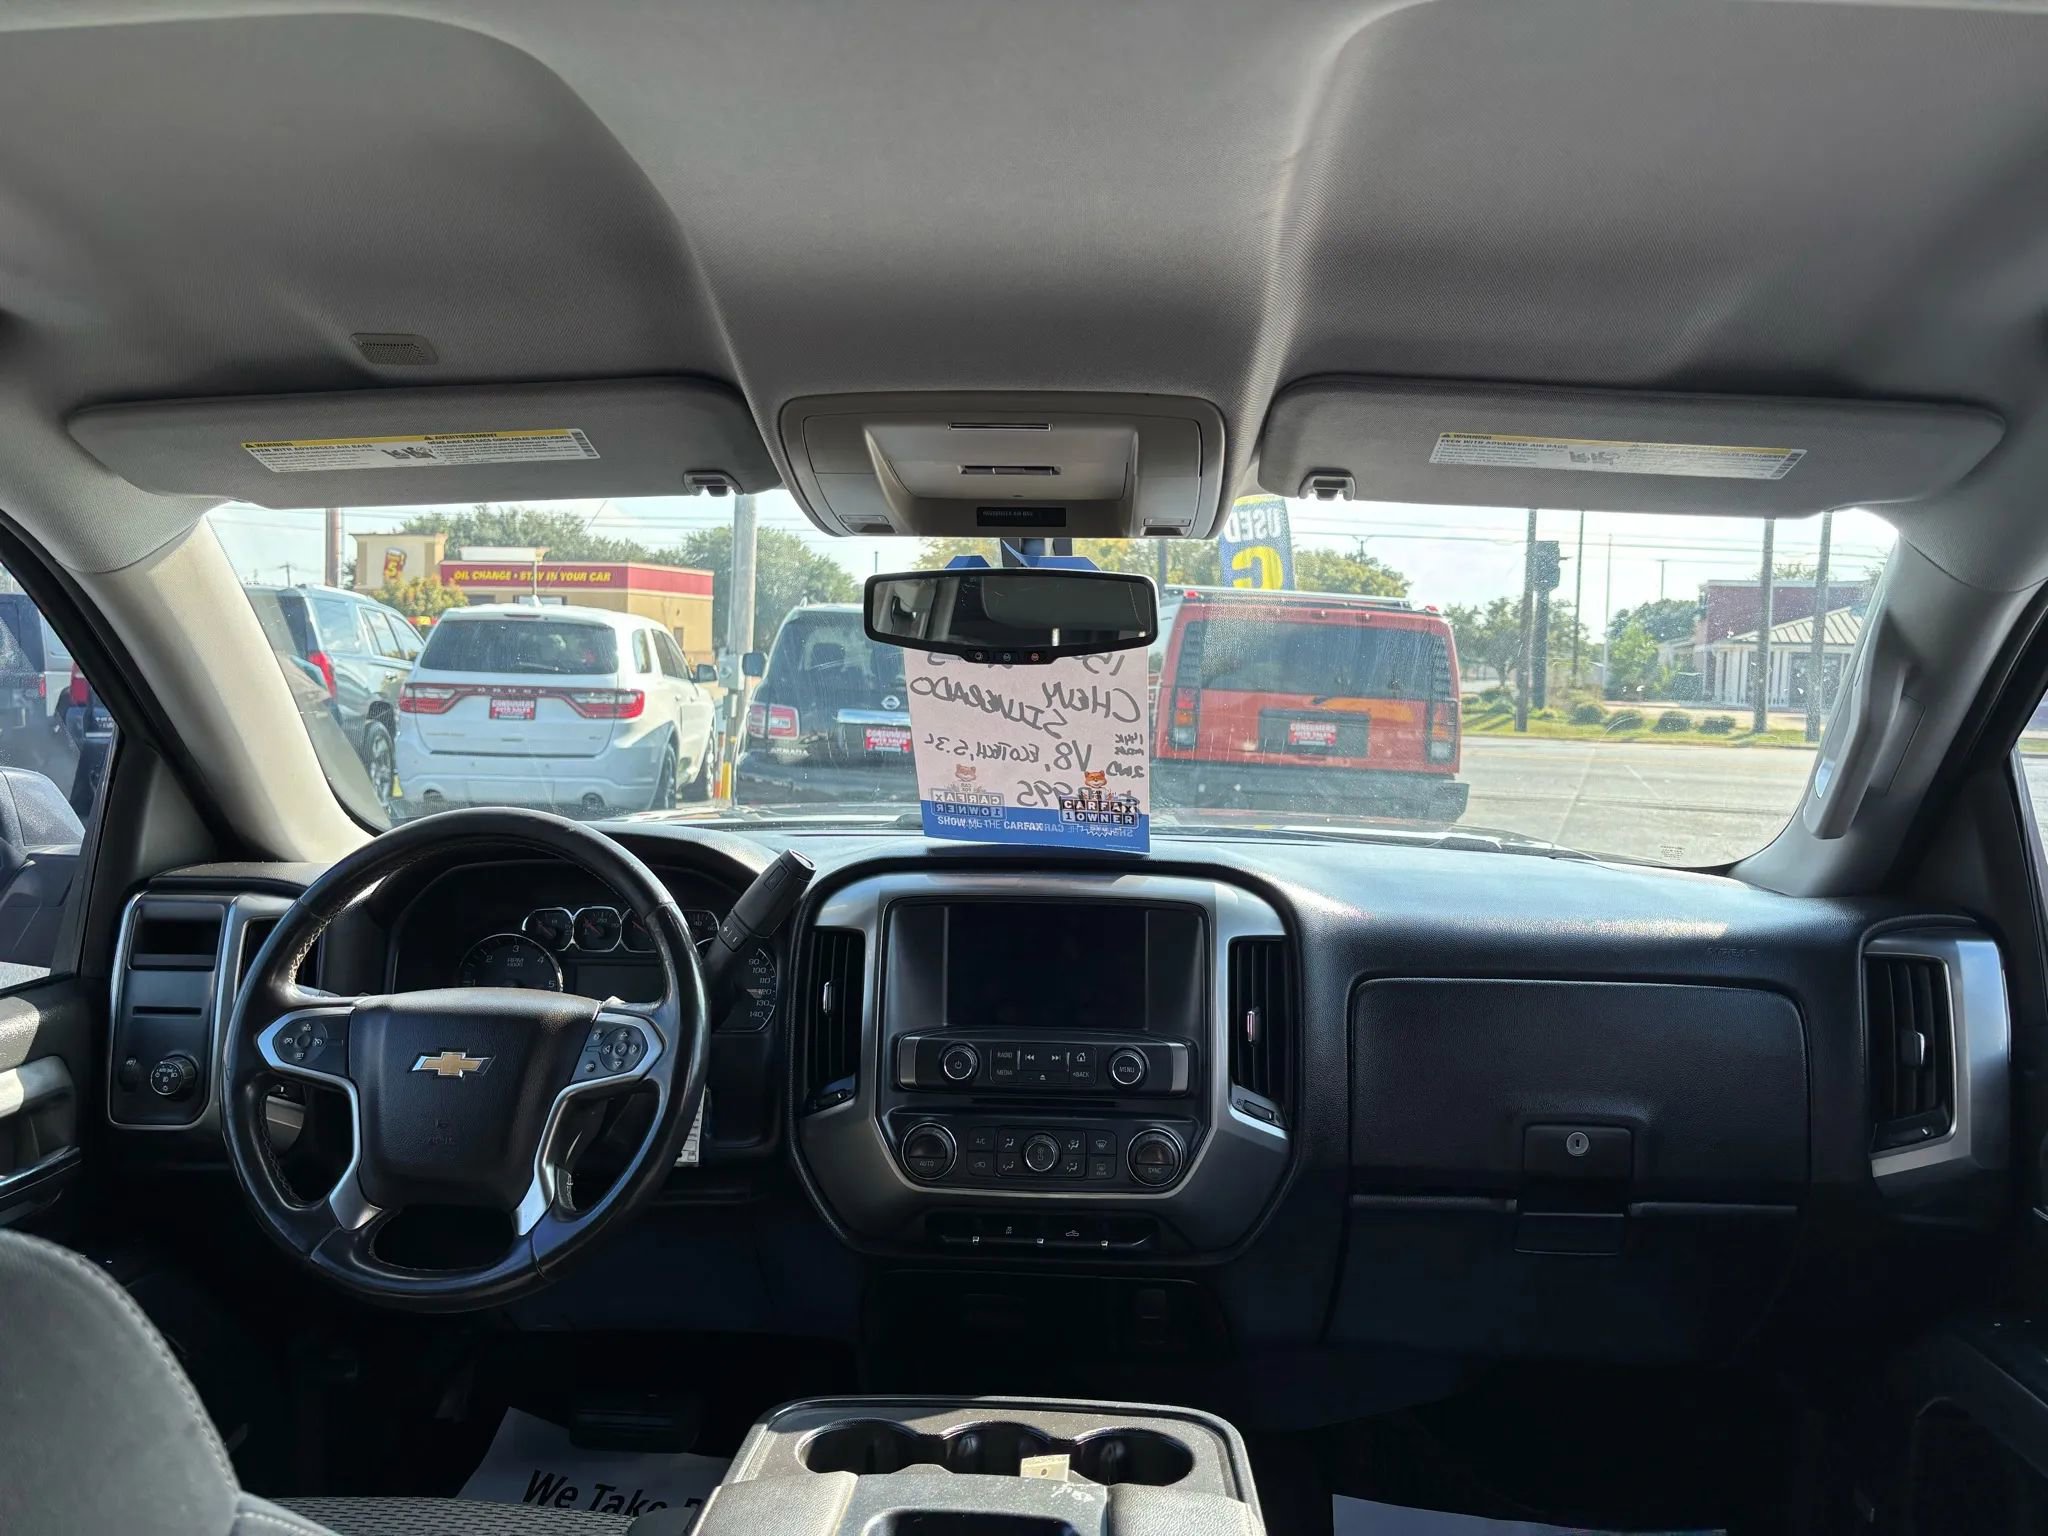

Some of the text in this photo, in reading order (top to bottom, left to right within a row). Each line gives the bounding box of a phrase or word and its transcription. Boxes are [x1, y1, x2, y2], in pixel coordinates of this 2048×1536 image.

[453, 571, 470, 581] OIL
[472, 570, 511, 581] CHANGE
[559, 571, 587, 582] YOUR
[589, 572, 612, 582] CAR
[1063, 800, 1135, 815] CARFAX
[938, 816, 966, 827] SHOW
[752, 966, 767, 974] 100
[997, 1051, 1013, 1059] RADIO
[919, 1160, 935, 1168] AUTO
[522, 1469, 579, 1509] We
